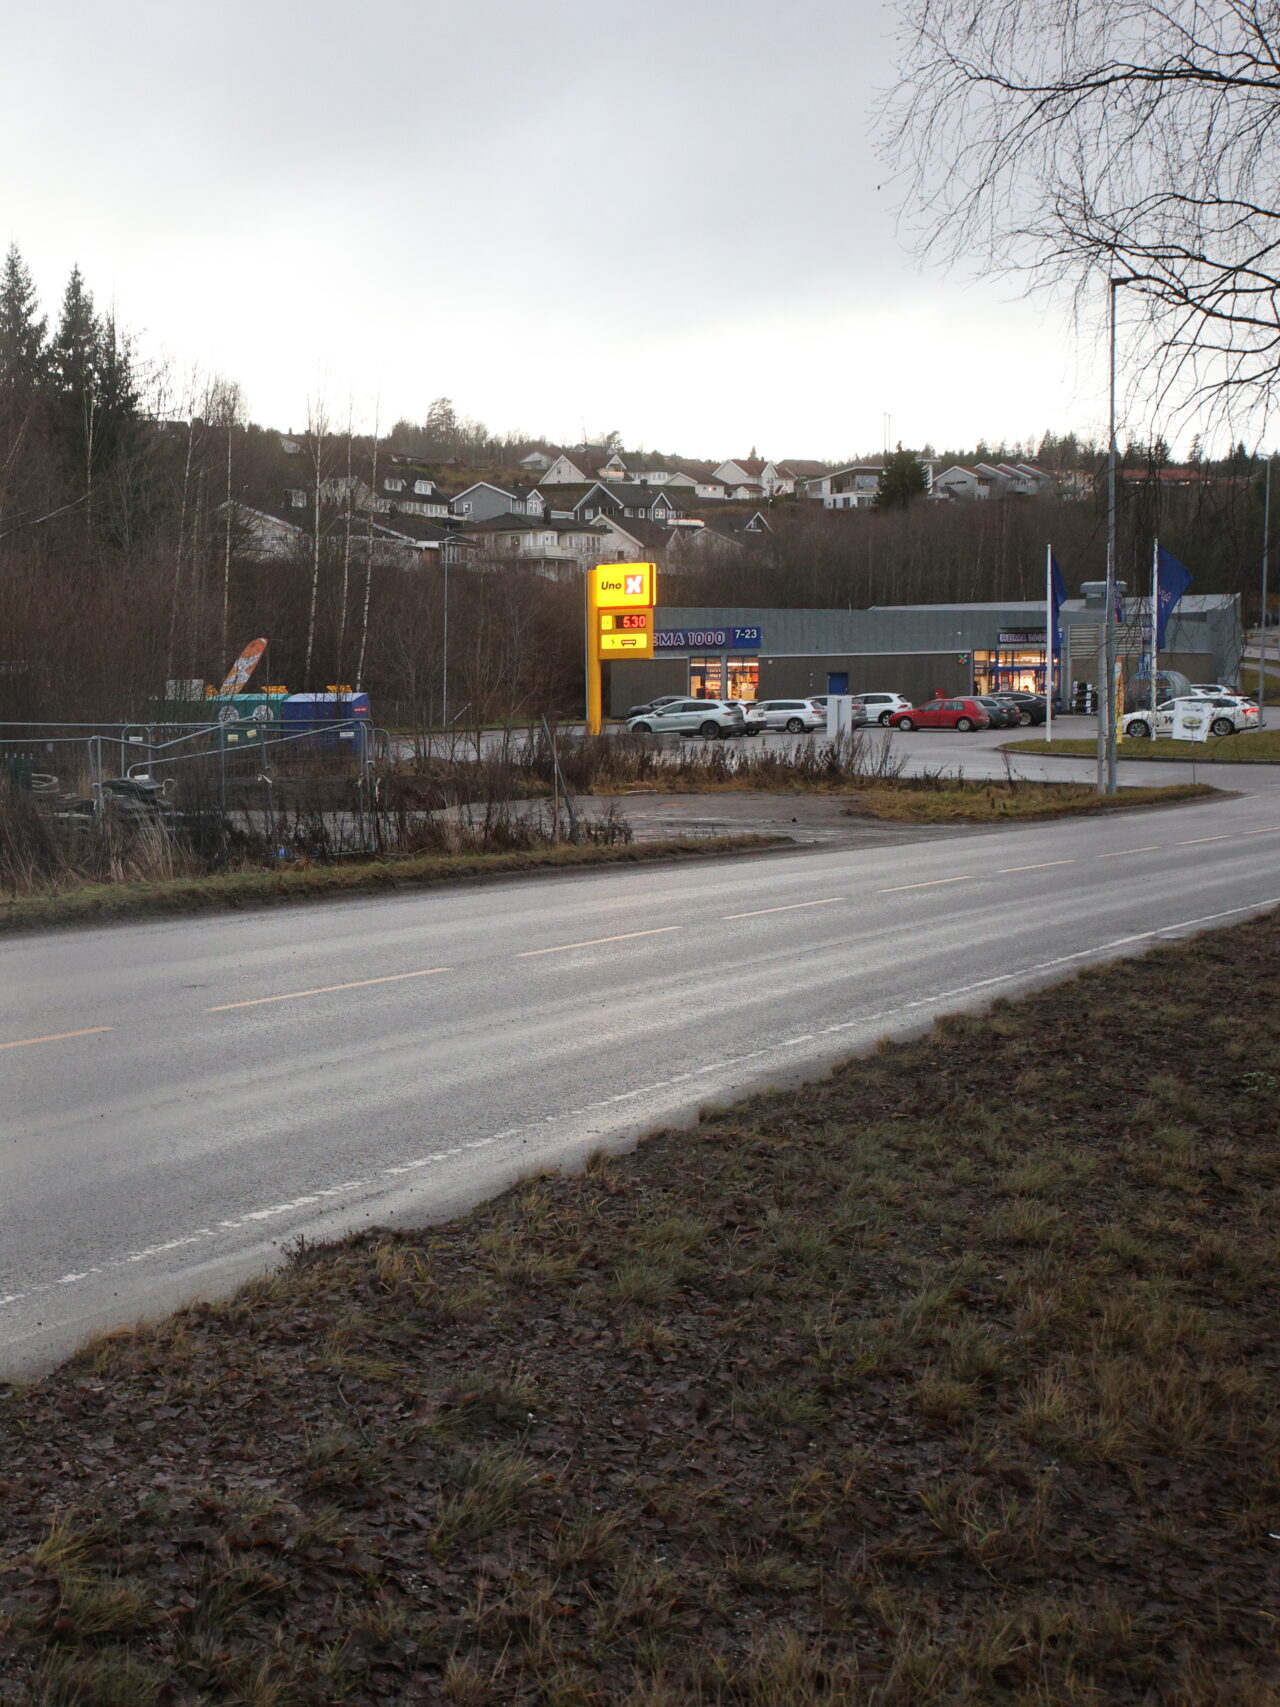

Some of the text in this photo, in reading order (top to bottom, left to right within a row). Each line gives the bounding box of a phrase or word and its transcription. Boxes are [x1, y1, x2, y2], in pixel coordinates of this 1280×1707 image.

[601, 575, 643, 594] Uno X
[653, 631, 726, 647] EMA 1000
[734, 629, 758, 639] 7-23
